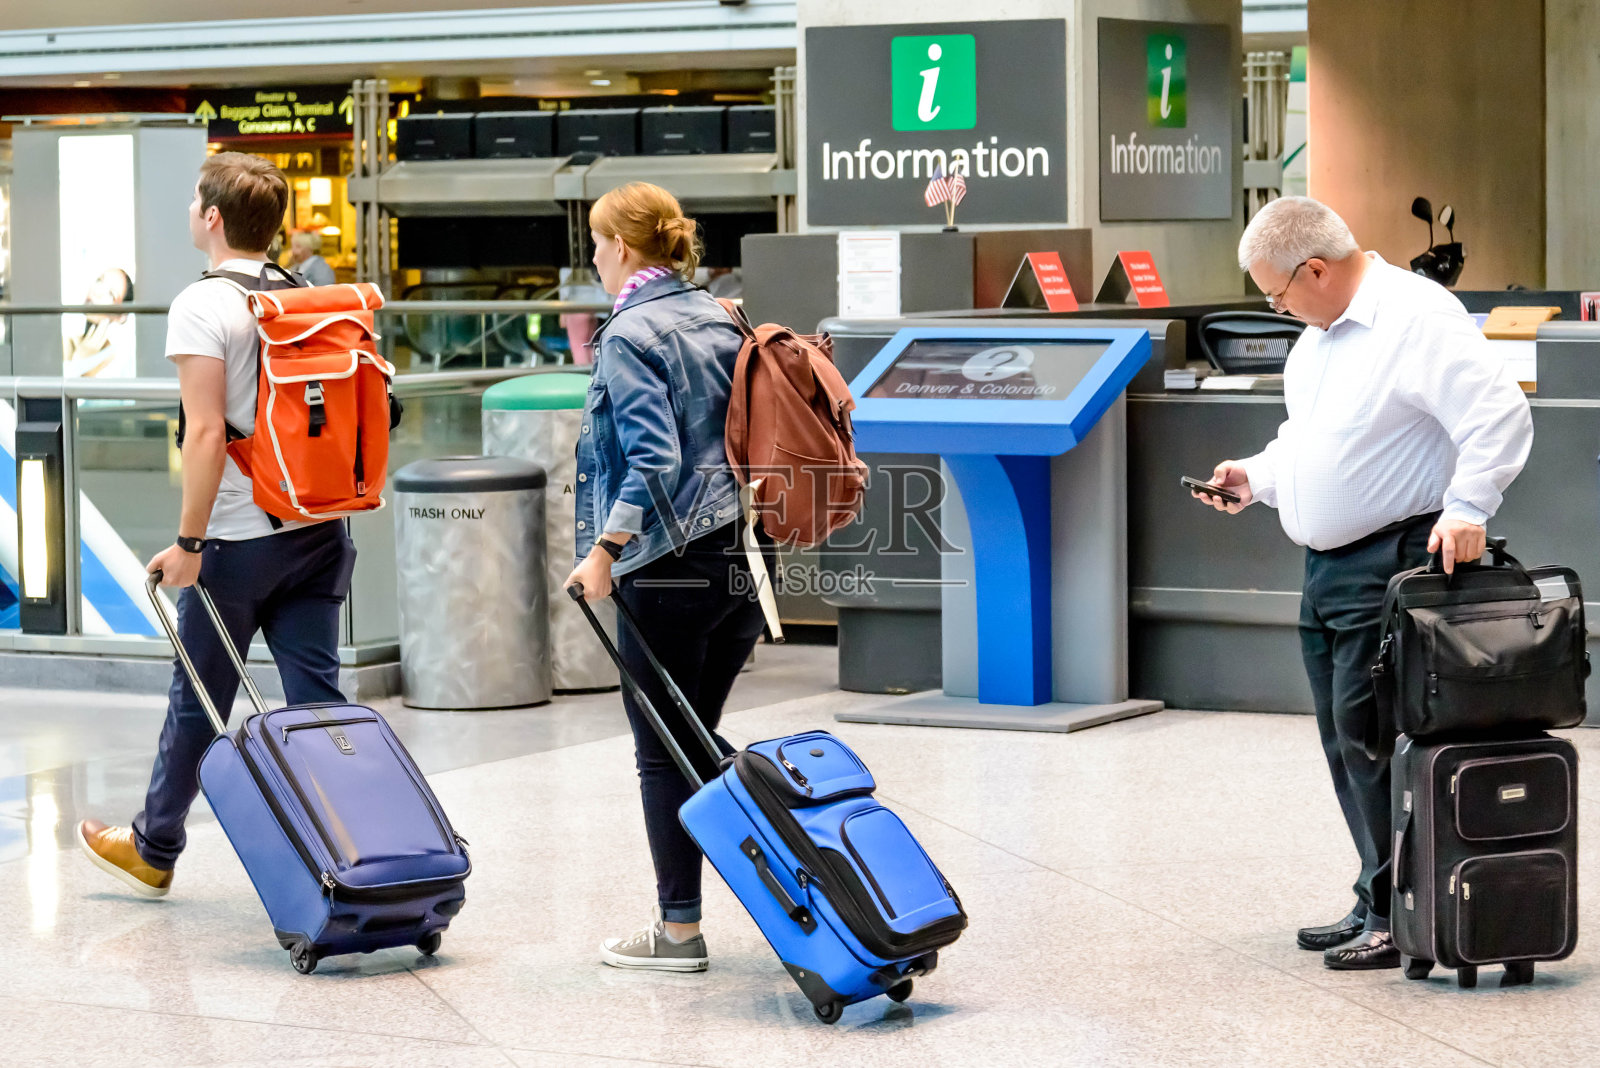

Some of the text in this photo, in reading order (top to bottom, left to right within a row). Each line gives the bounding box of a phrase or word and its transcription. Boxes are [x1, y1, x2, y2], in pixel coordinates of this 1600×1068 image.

[293, 101, 334, 116] Terminal
[306, 117, 316, 132] C
[822, 136, 1049, 180] Information
[1110, 131, 1222, 175] Information
[894, 382, 1057, 395] Denver & Colorado
[408, 507, 486, 520] TRASH ONLY
